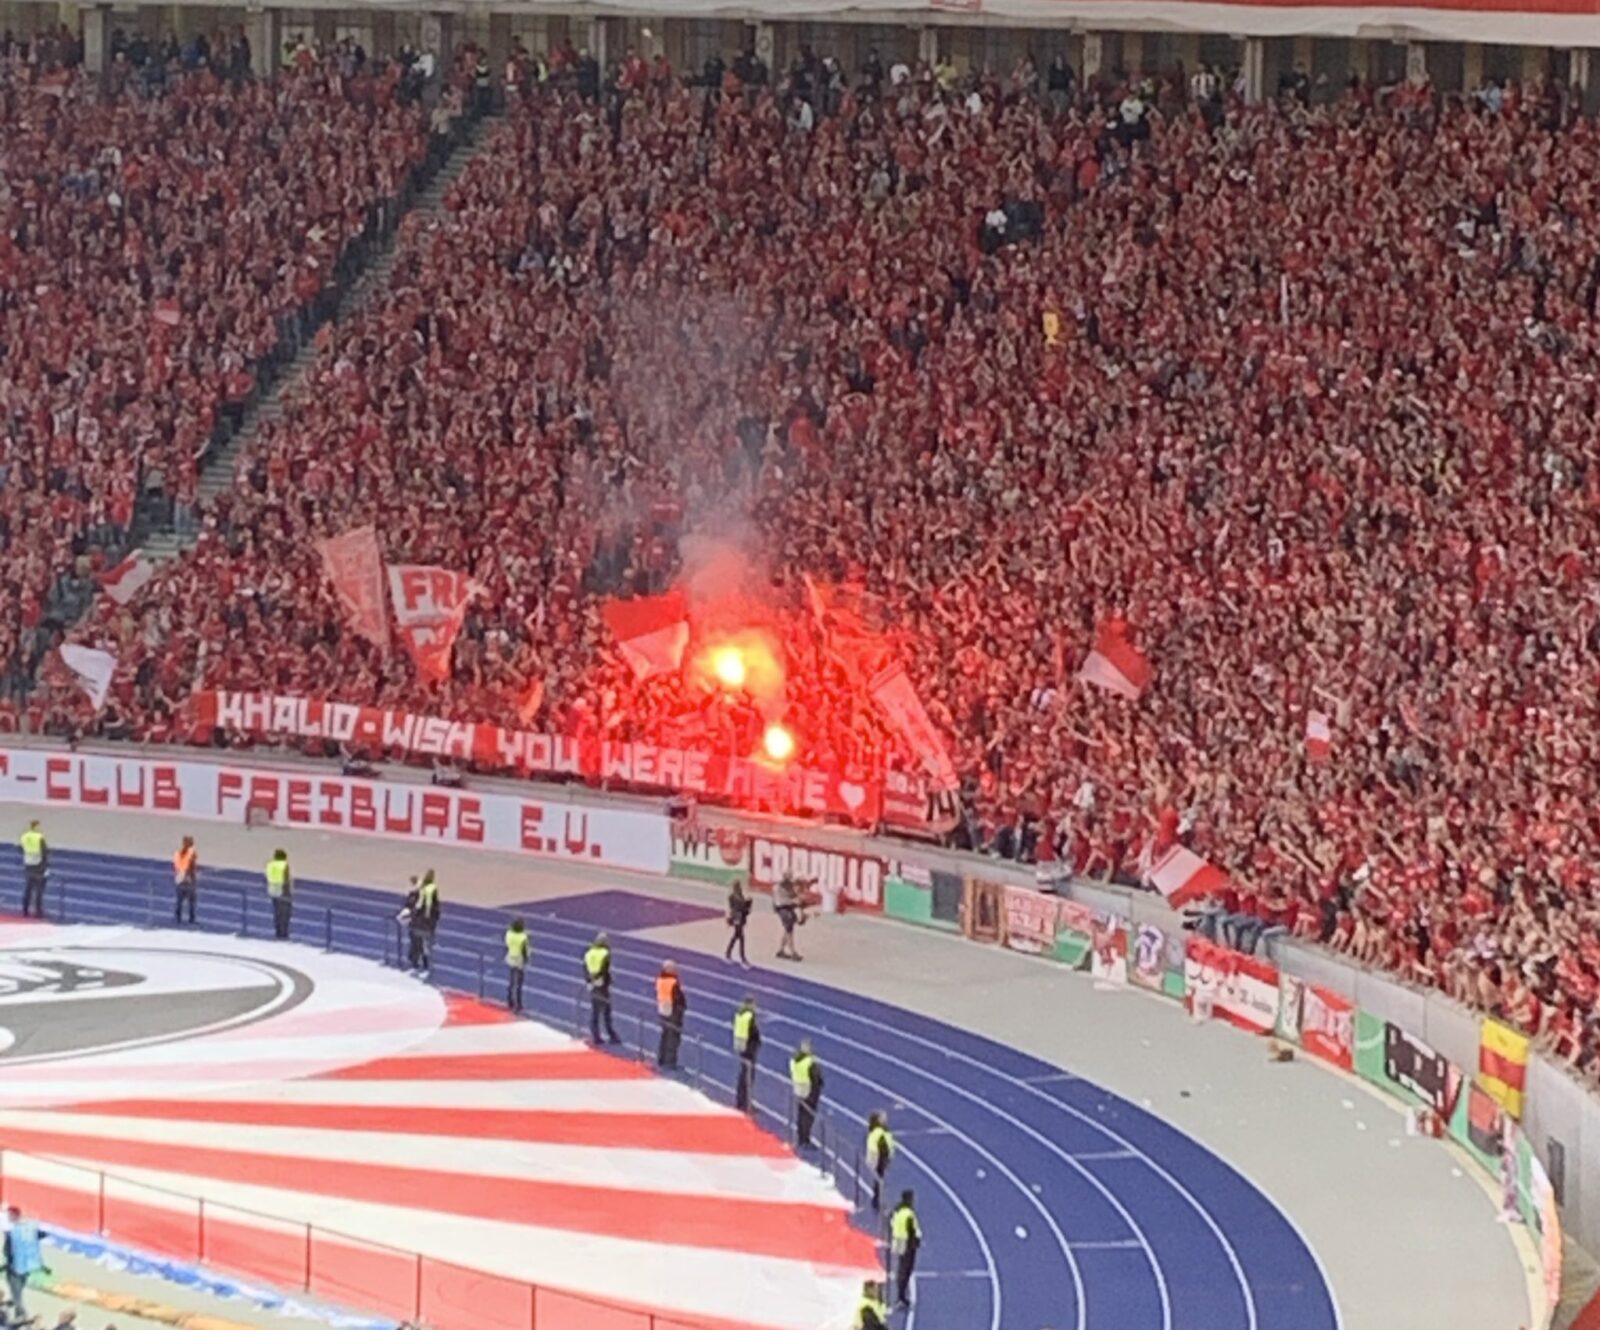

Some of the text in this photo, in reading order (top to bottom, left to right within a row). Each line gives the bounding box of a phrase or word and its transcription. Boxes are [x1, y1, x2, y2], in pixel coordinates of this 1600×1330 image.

[217, 690, 360, 741] KHALID
[383, 710, 475, 762] WISH
[497, 730, 579, 775] YOU
[601, 740, 709, 790] WERE
[217, 772, 485, 843] FREIBURG
